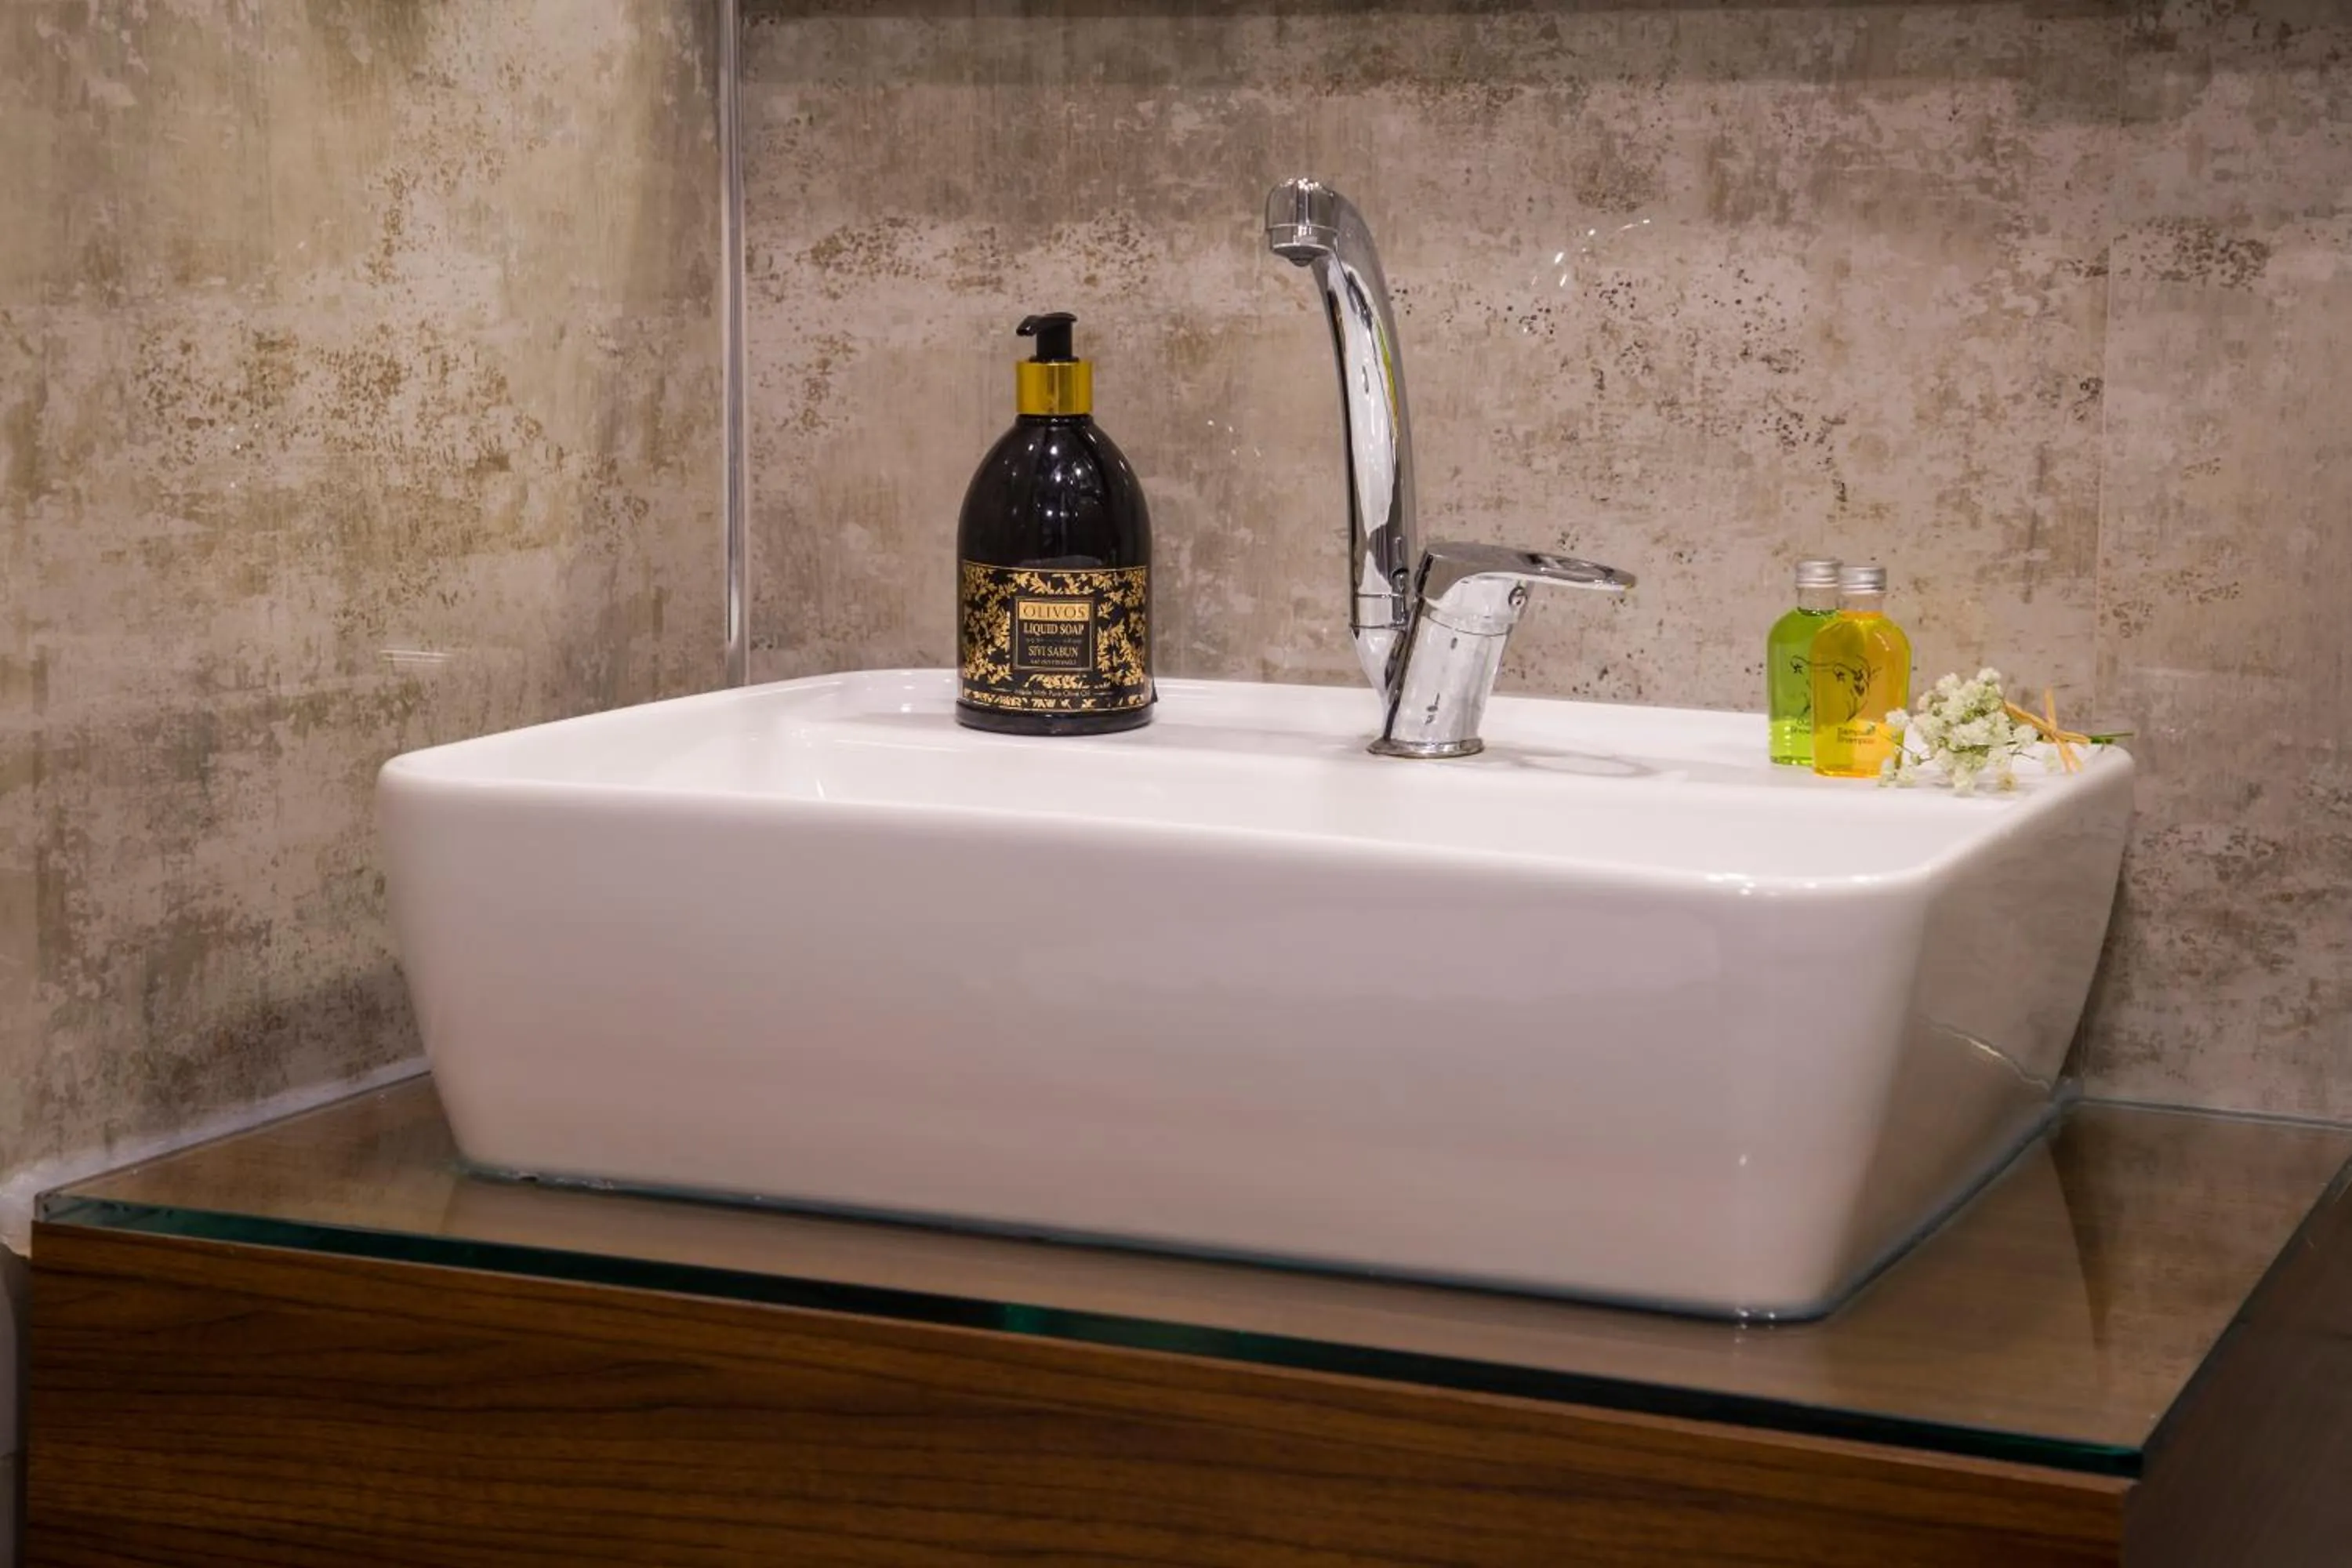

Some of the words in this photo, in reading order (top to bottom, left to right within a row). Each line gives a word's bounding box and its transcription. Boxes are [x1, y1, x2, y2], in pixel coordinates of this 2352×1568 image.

[1023, 604, 1085, 619] OLIVOS
[1023, 622, 1058, 636] LIQUID
[1059, 624, 1084, 635] SOAP
[1047, 646, 1078, 657] SABUN
